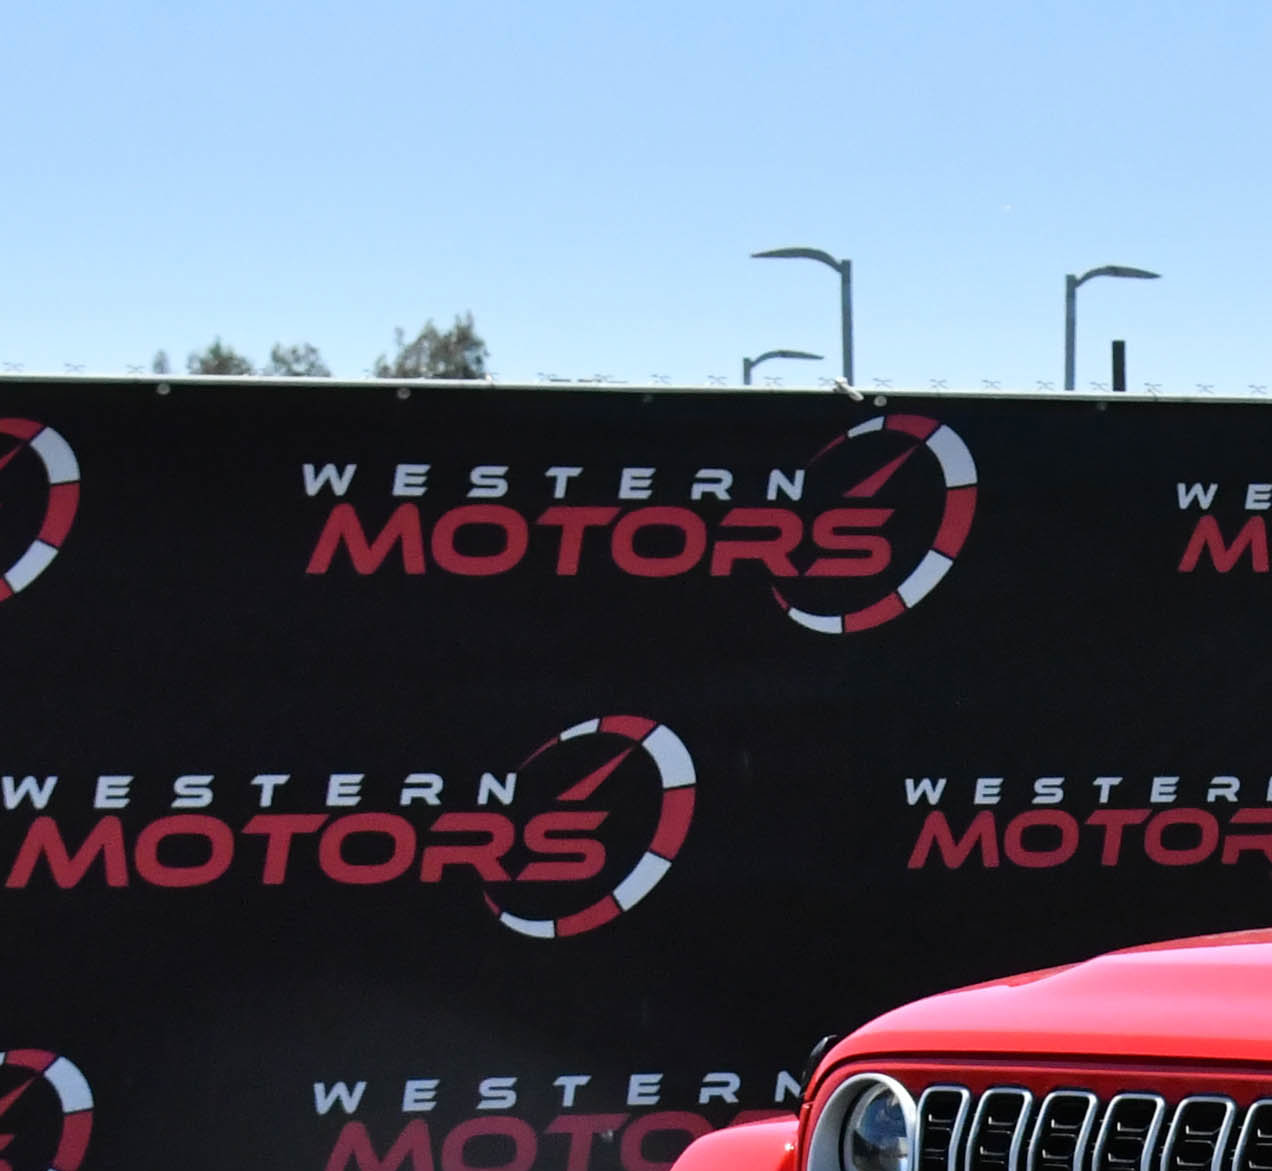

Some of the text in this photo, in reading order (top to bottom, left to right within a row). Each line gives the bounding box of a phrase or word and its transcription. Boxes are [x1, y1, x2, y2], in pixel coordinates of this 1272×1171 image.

[303, 463, 805, 501] WESTERN
[307, 503, 894, 577] MOTORS
[2, 772, 517, 810] WESTERN
[6, 811, 608, 888] MOTORS
